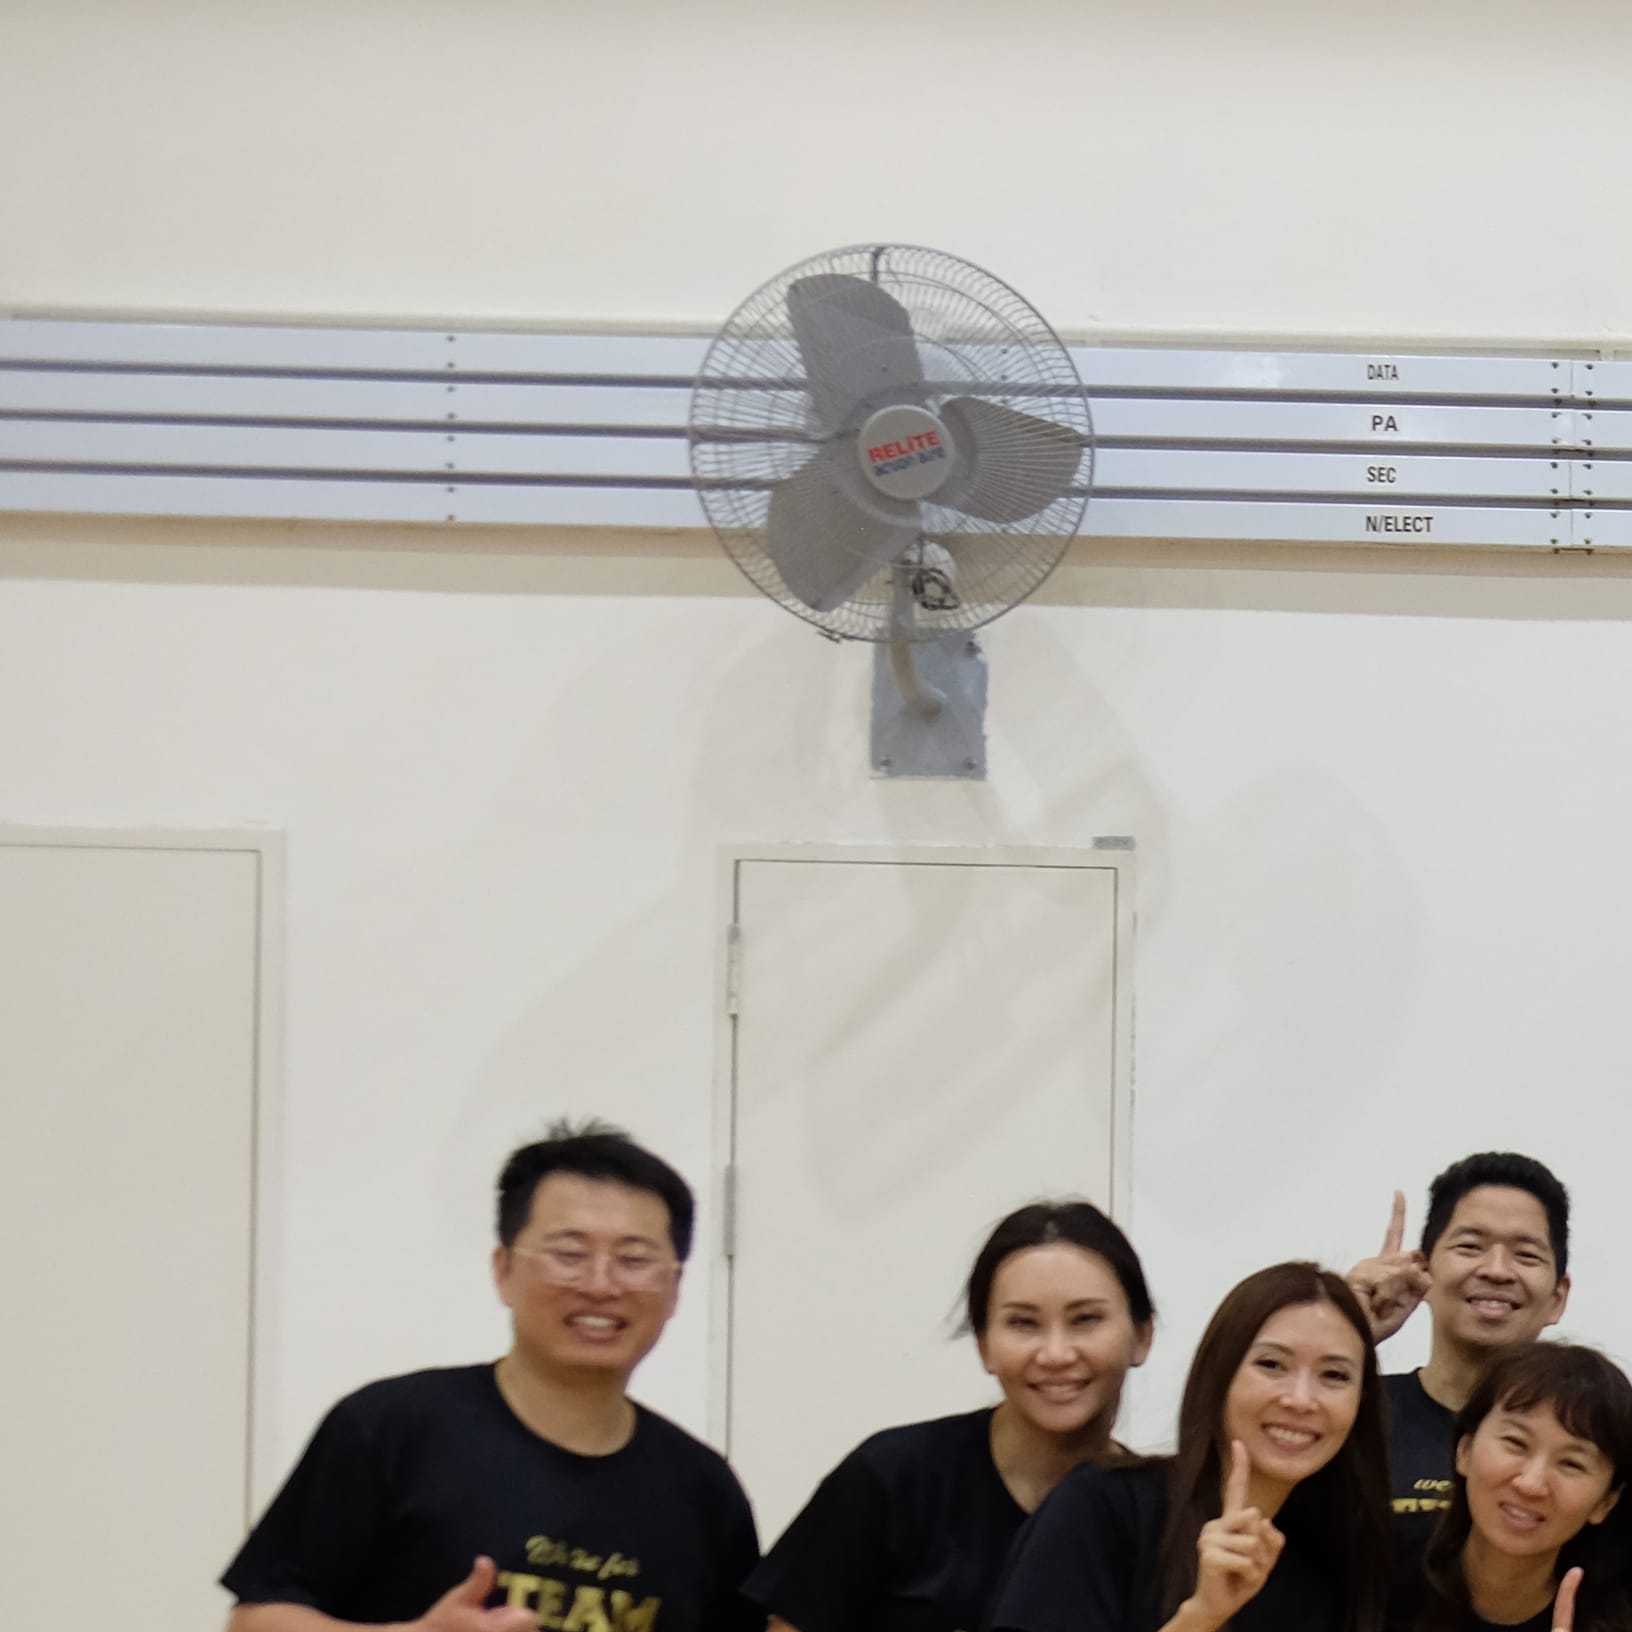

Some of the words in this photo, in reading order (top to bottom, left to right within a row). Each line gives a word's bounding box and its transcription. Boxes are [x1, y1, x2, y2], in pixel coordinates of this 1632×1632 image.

[1367, 364, 1399, 380] DATA
[1371, 415, 1399, 432] PA
[1366, 466, 1397, 483] SEC
[1365, 515, 1434, 533] N/ELECT
